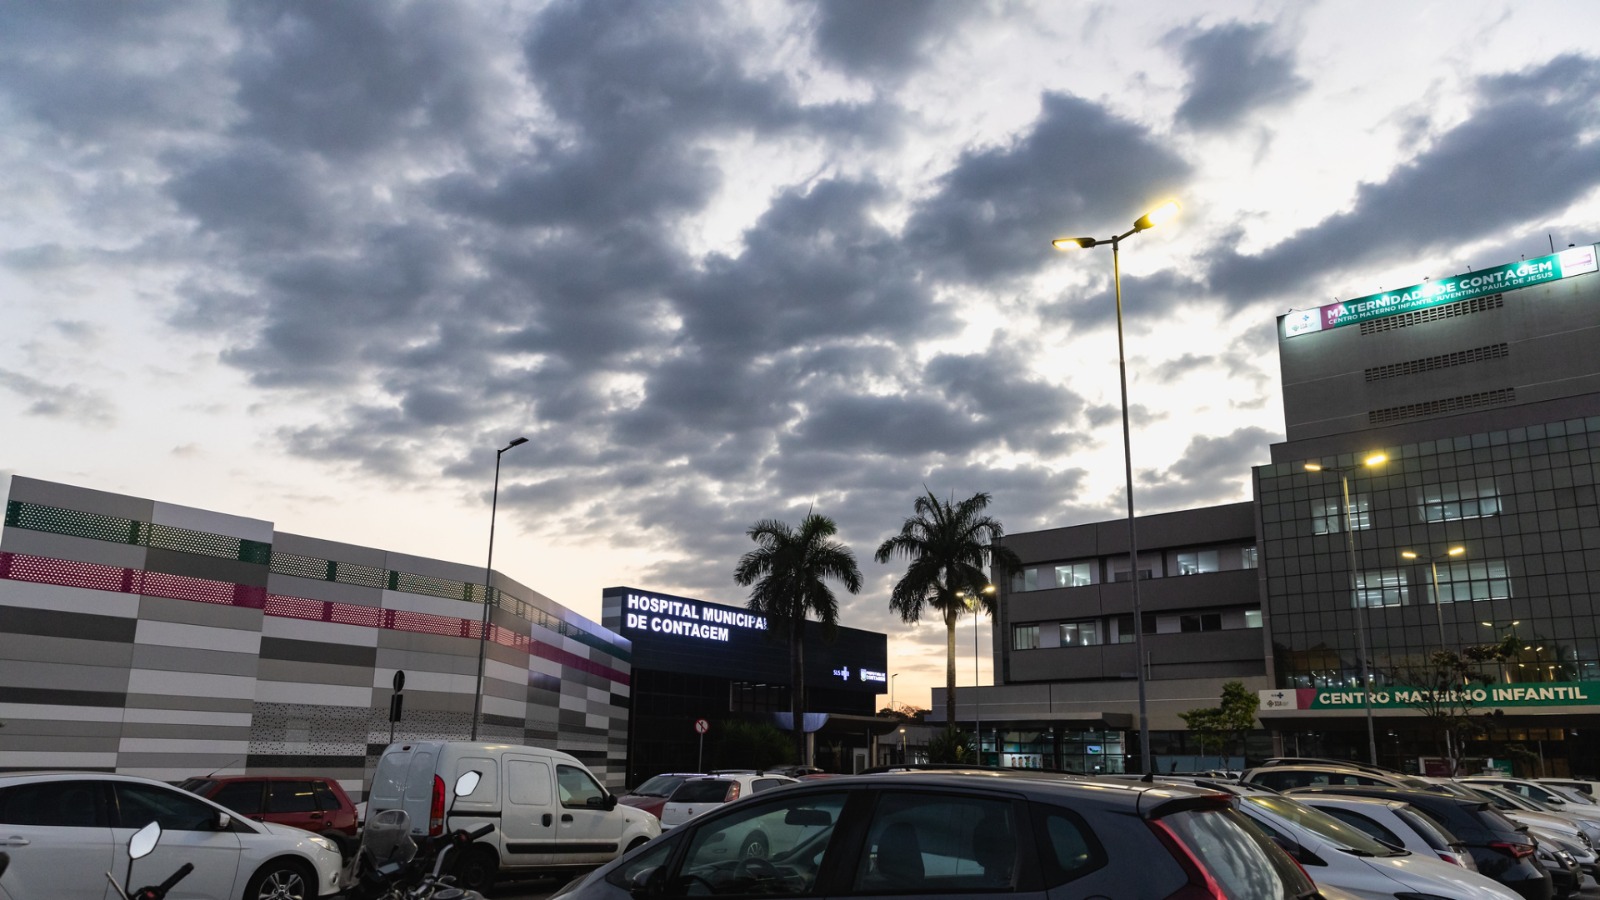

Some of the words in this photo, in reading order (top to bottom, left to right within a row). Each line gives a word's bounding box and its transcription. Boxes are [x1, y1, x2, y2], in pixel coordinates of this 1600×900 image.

[1327, 288, 1432, 319] MATERNIDAD
[1435, 282, 1456, 295] DE
[1460, 261, 1553, 289] CONTAGEM
[1328, 314, 1358, 325] CENTRO
[1359, 305, 1397, 319] MATERNO
[1398, 298, 1434, 310] INFANTIL
[1434, 287, 1481, 302] JUVENTINA
[1482, 280, 1511, 292] PAULA
[1513, 277, 1525, 285] DE
[1527, 271, 1554, 283] JESUS
[627, 594, 699, 620] HOSPITAL
[626, 613, 647, 630] DE
[651, 618, 729, 642] CONTAGEM
[1319, 691, 1390, 705] CENTRO
[1493, 686, 1588, 702] INFANTIL
